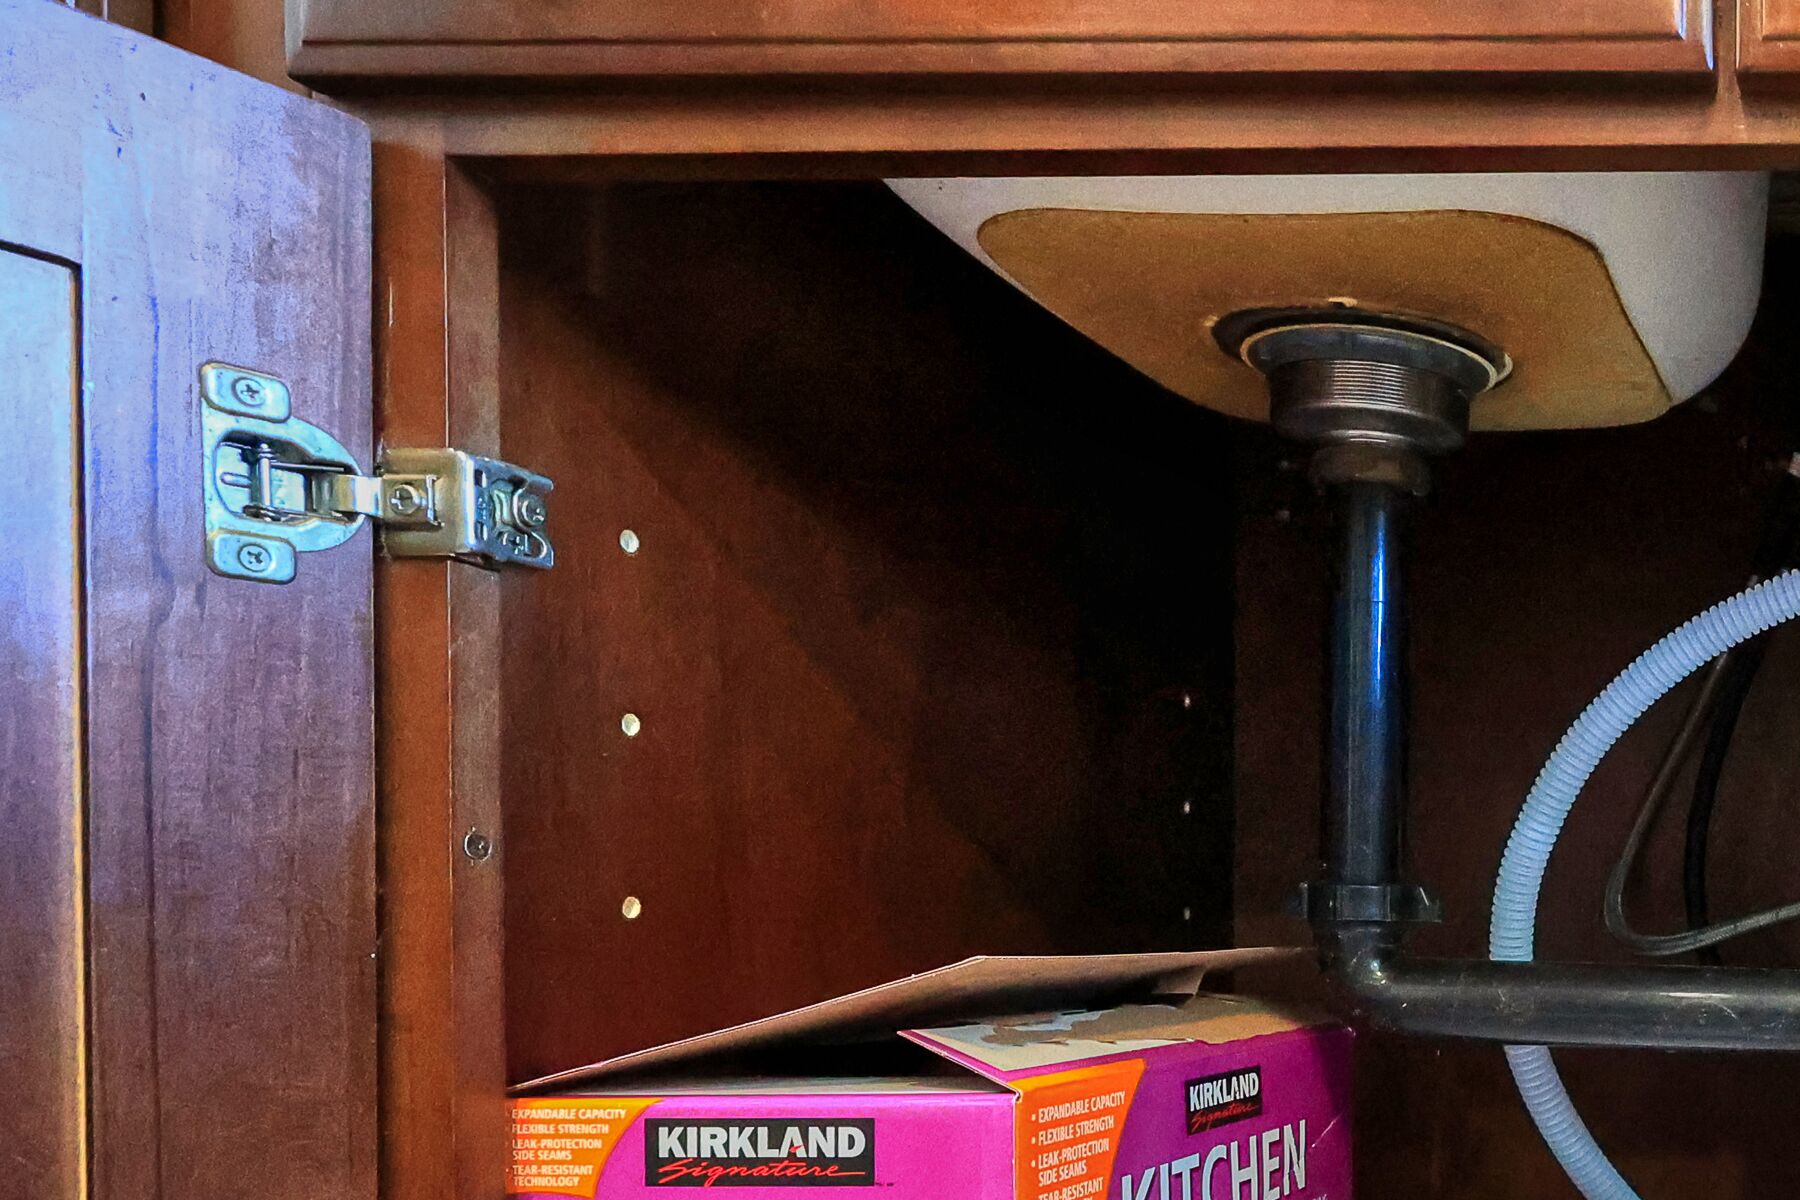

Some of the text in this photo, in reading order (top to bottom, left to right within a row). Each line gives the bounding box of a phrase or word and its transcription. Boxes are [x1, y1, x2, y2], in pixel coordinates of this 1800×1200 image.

[1189, 1072, 1259, 1113] KIRKLAND
[512, 1108, 627, 1120] EXPANDABLE CAPACITY
[1039, 1091, 1126, 1124] EXPANDABLE CAPACITY
[1190, 1101, 1258, 1132] Signature
[512, 1123, 610, 1135] FLEXIBLE STRENGTH
[512, 1138, 603, 1149] LEAK-PROTECTION
[658, 1125, 866, 1159] KIRKLAND
[1039, 1115, 1114, 1146] FLEXIBLE STRENGTH
[512, 1149, 573, 1161] SIDE SEAMS
[1039, 1138, 1110, 1169] LEAK-PROTECTION
[512, 1164, 594, 1176] TEAR-RESISTANT
[513, 1176, 580, 1187] TECHNOLOGY
[657, 1157, 866, 1187] Signature
[1039, 1159, 1087, 1187] SIDE SEAMS
